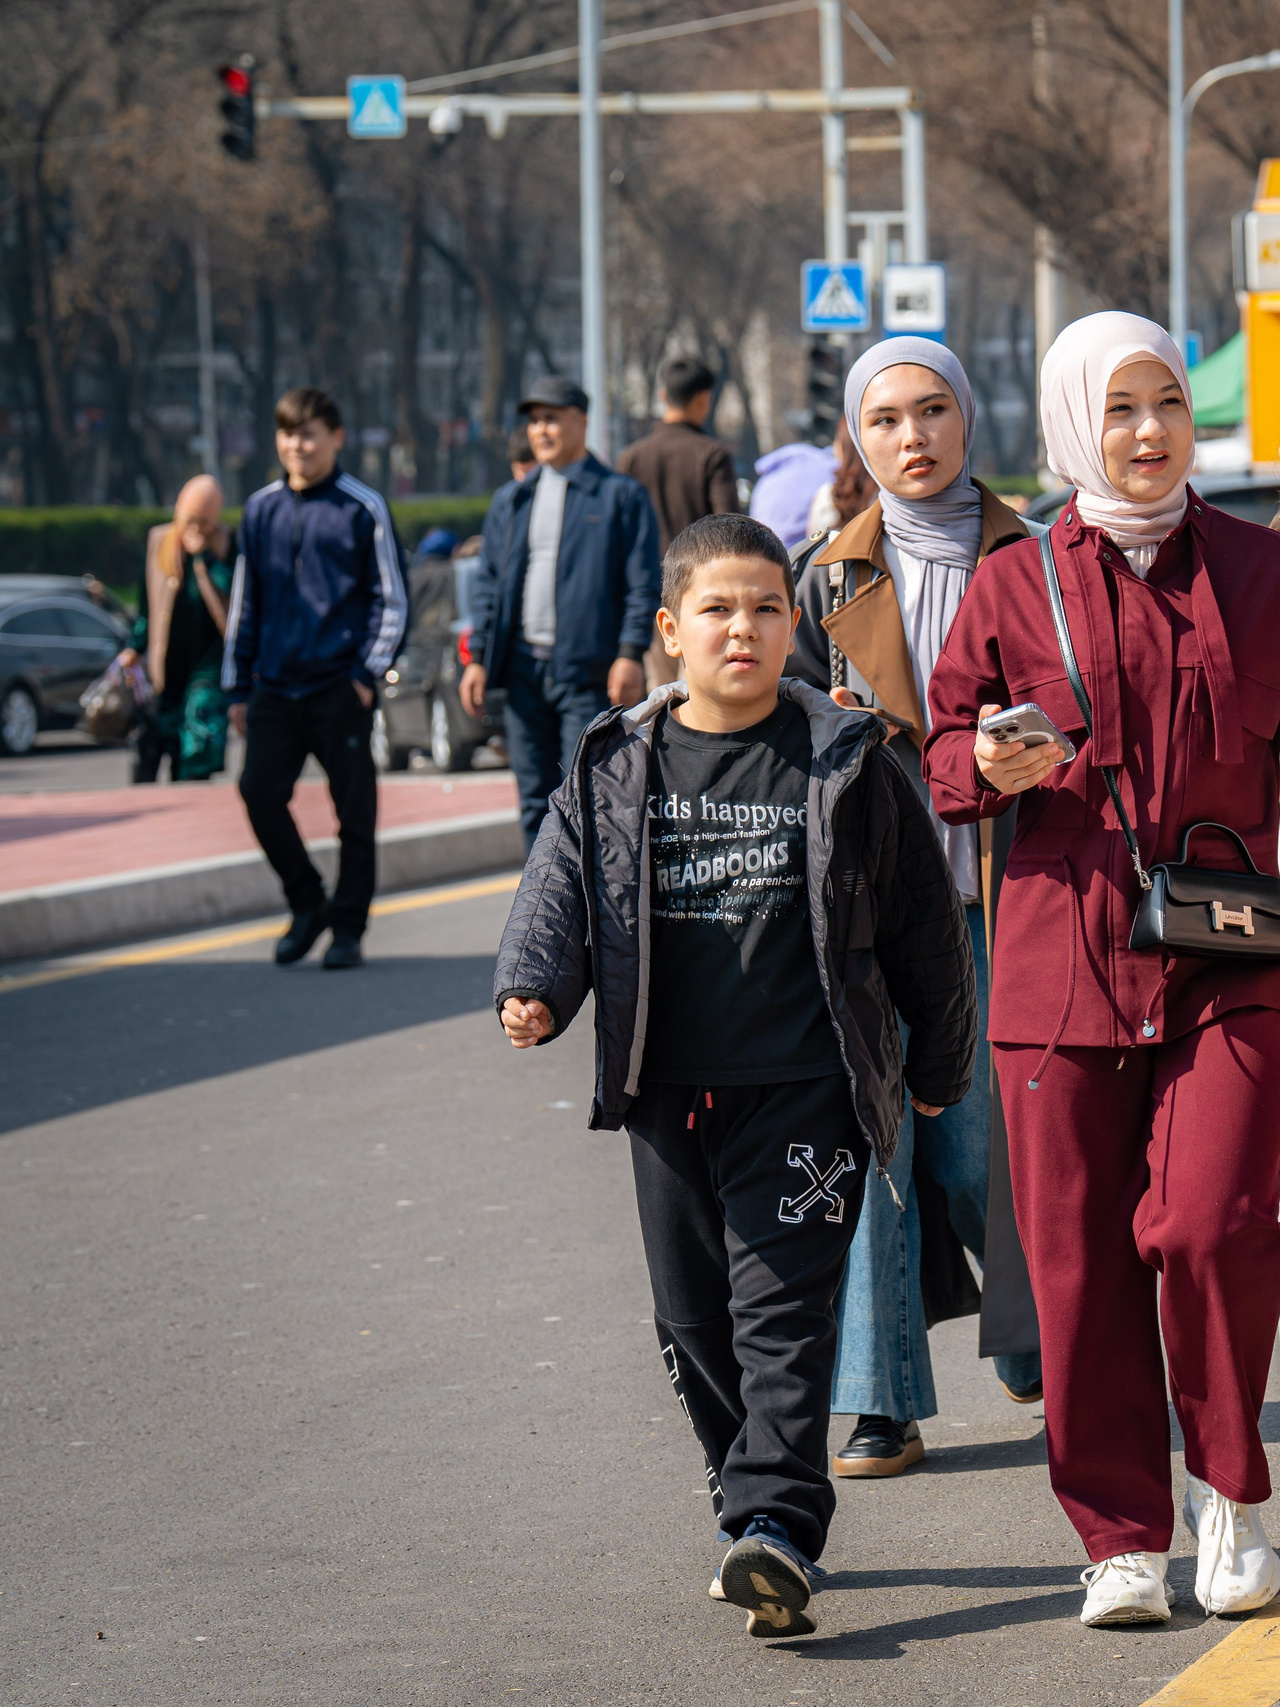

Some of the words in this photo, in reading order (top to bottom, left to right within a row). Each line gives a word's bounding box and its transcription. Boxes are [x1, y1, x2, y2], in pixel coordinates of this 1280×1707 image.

[647, 793, 692, 819] Kids
[702, 831, 737, 842] high-end
[739, 829, 770, 839] fashion
[656, 841, 789, 892] READBOOKS
[668, 910, 686, 919] with
[688, 910, 701, 919] the
